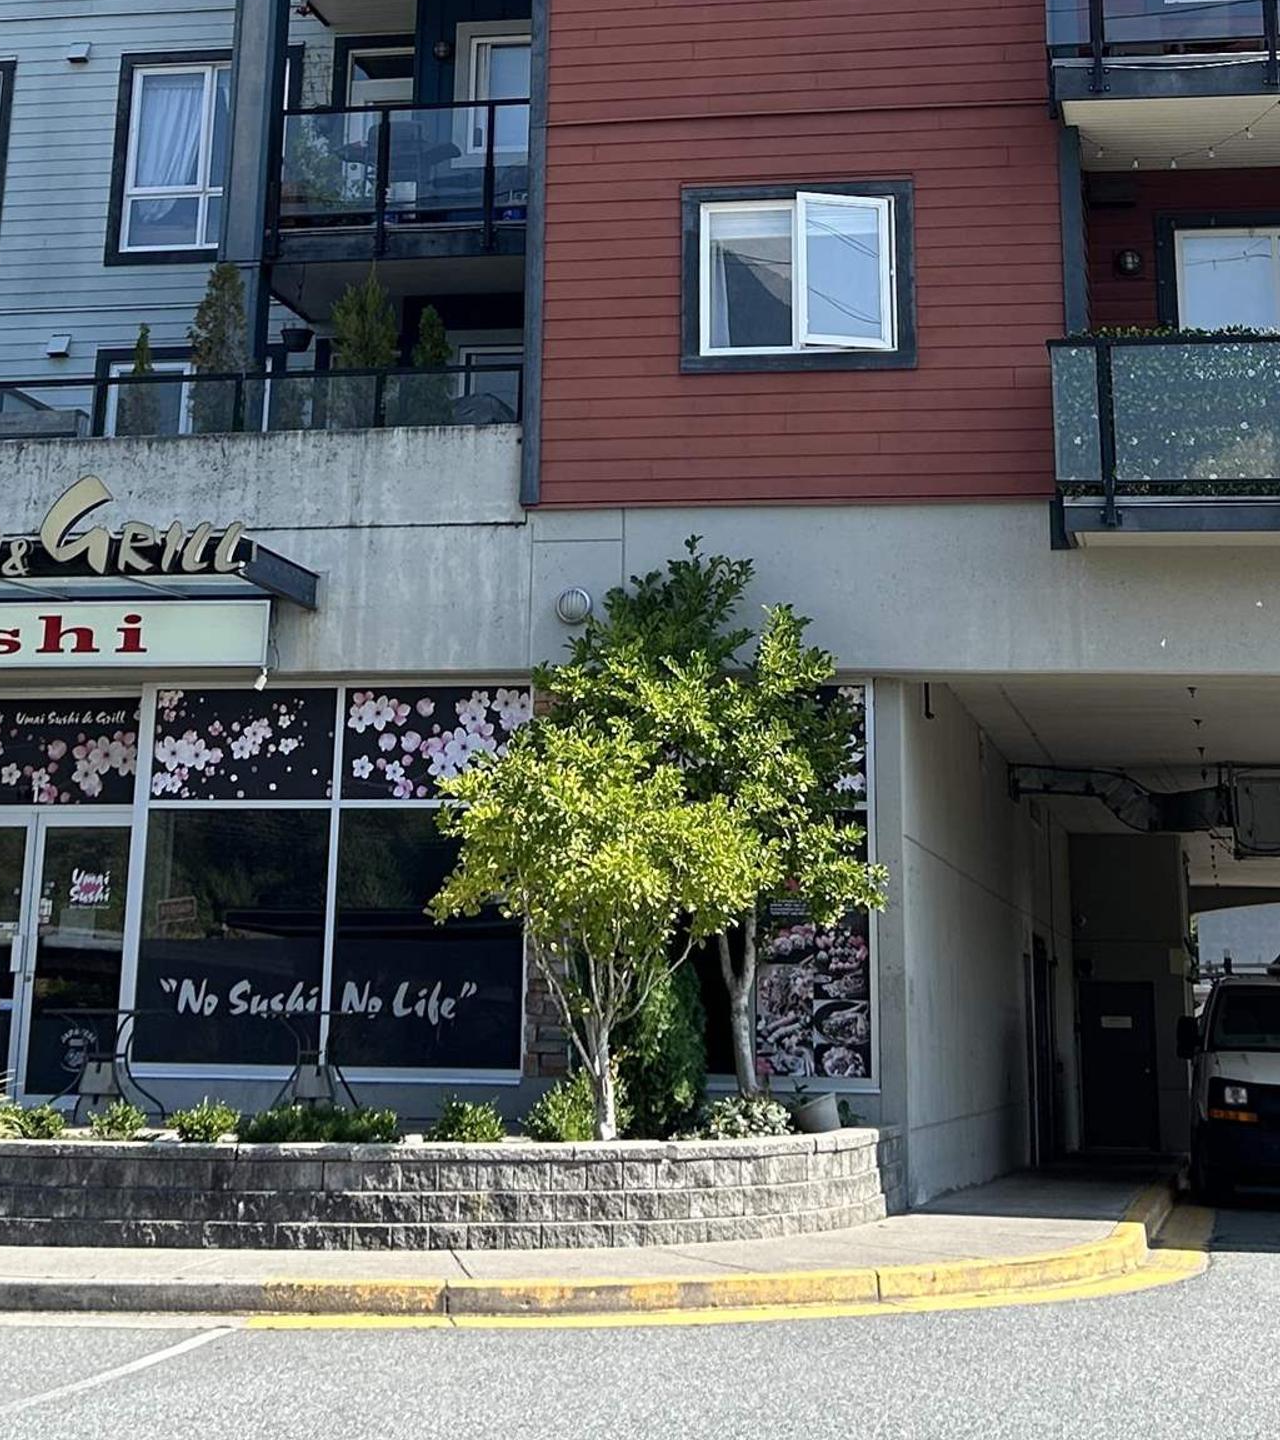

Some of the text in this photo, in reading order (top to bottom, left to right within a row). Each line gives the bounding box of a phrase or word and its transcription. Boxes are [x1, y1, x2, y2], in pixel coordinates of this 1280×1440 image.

[1, 538, 33, 576] &
[39, 474, 246, 574] GRILL
[16, 712, 46, 725] Umai
[47, 711, 80, 725] Sushi
[95, 711, 126, 725] Grill
[228, 979, 320, 1016] Sushi
[341, 980, 383, 1017] No
